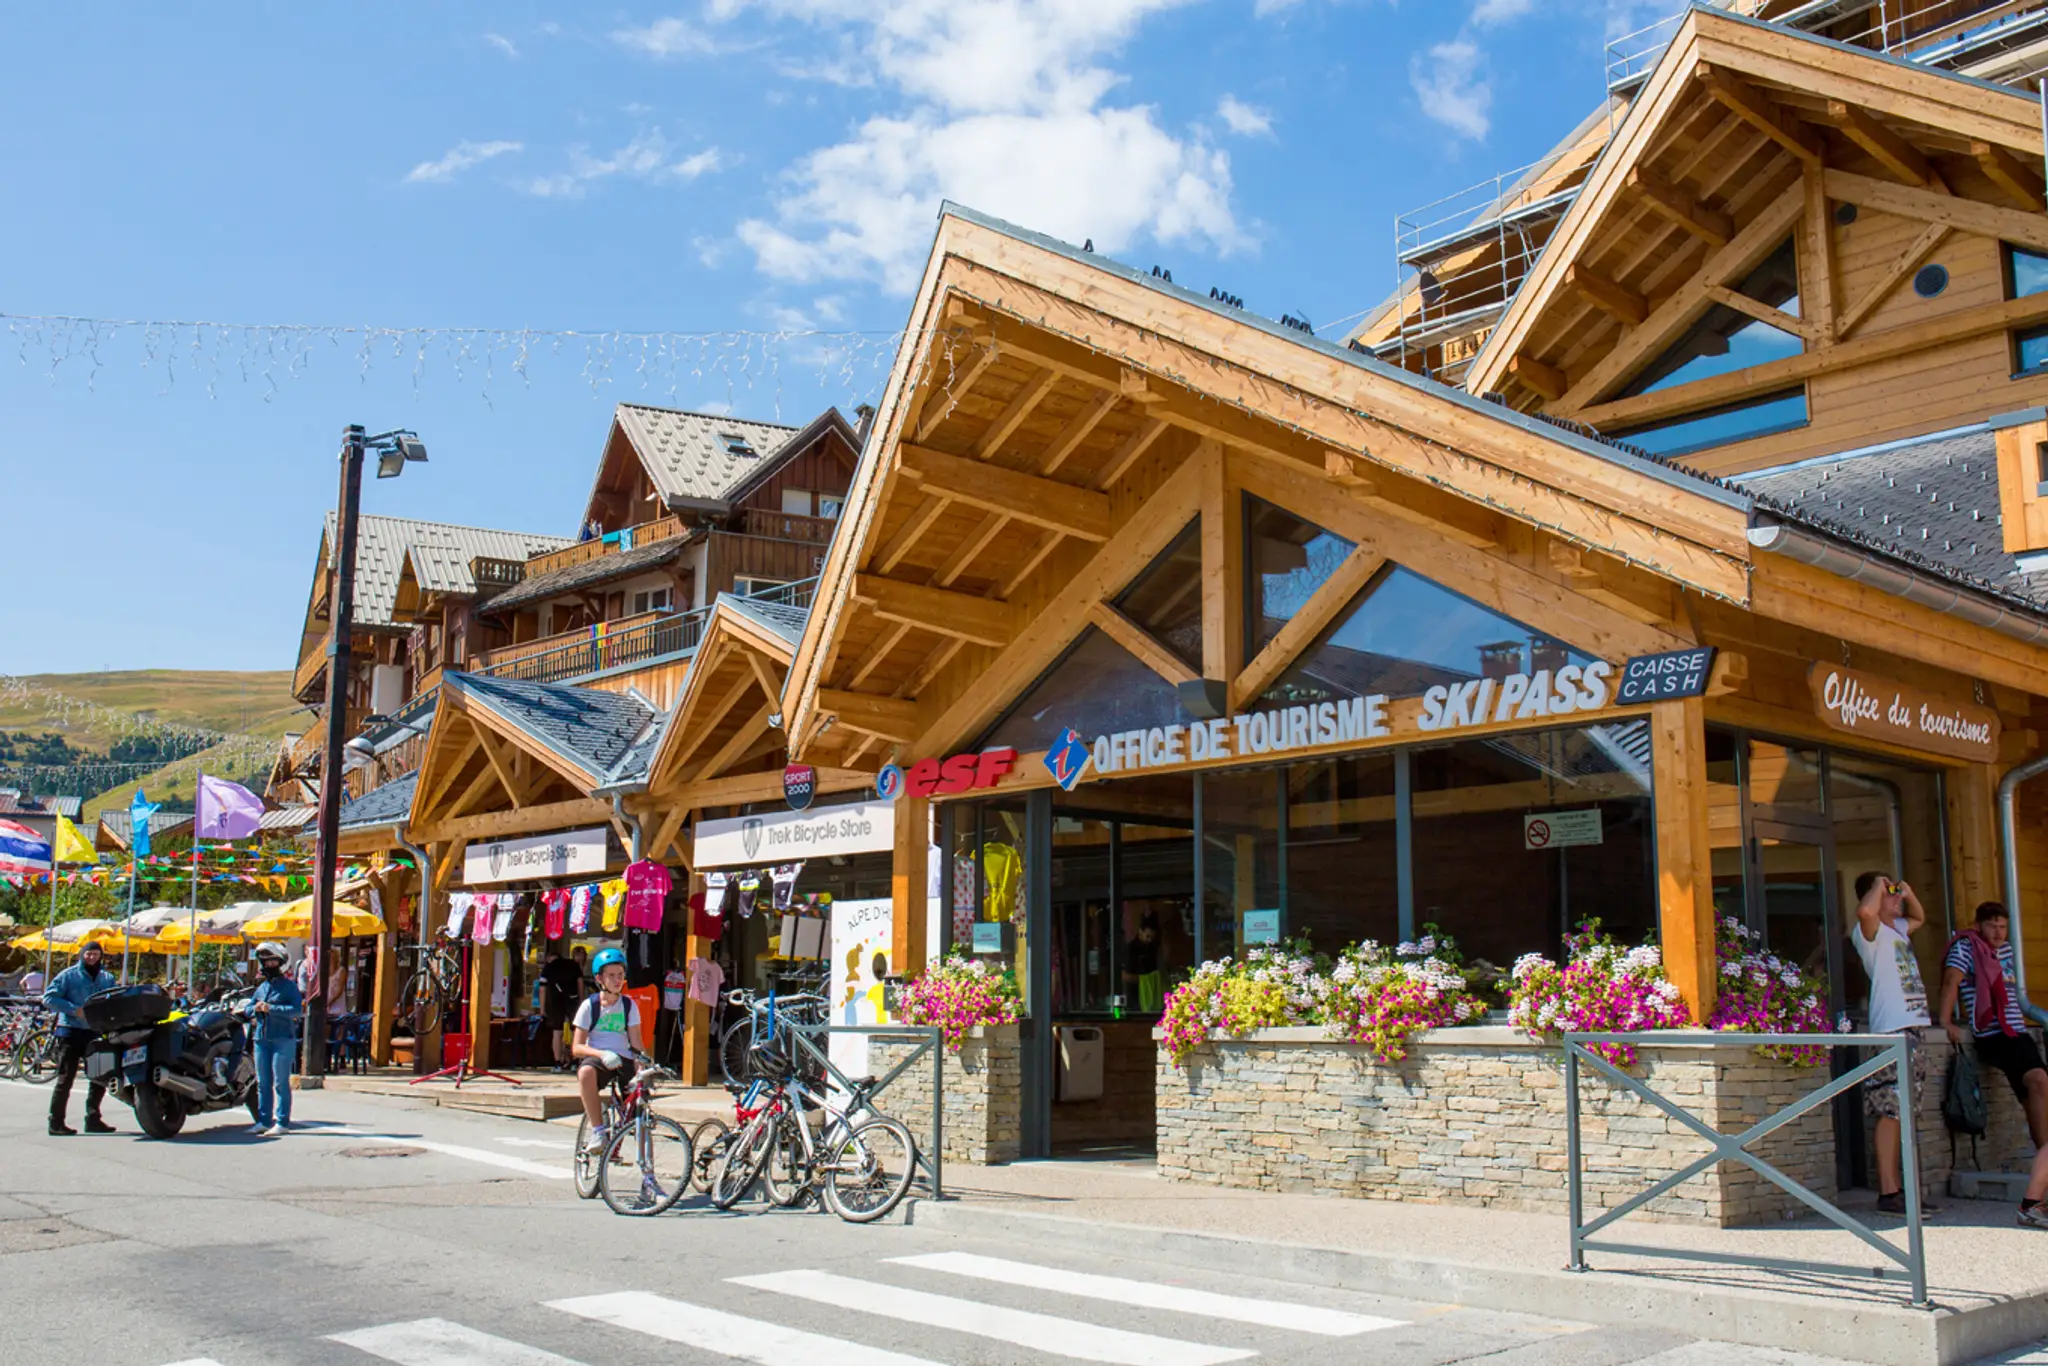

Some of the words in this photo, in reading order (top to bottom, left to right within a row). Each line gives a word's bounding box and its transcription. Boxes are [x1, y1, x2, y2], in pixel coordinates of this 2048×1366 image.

[1629, 652, 1705, 679] CAISSE
[1417, 677, 1497, 732] SKI
[1494, 660, 1617, 722] PASS
[1623, 672, 1700, 698] CASH
[1823, 671, 1880, 727] Office
[1887, 693, 1912, 729] du
[1918, 702, 1991, 745] tourisme
[1093, 723, 1186, 773] OFFICE
[1190, 717, 1232, 761] DE
[1234, 693, 1391, 753] TOURISME
[784, 771, 811, 785] SPORT
[787, 783, 810, 796] 2000
[768, 826, 792, 846] Trek
[794, 821, 838, 845] Bicycle
[840, 818, 872, 838] Store
[506, 852, 524, 867] Trek
[525, 847, 555, 866] Bicycle
[555, 844, 578, 861] Store
[847, 907, 872, 932] ALPE
